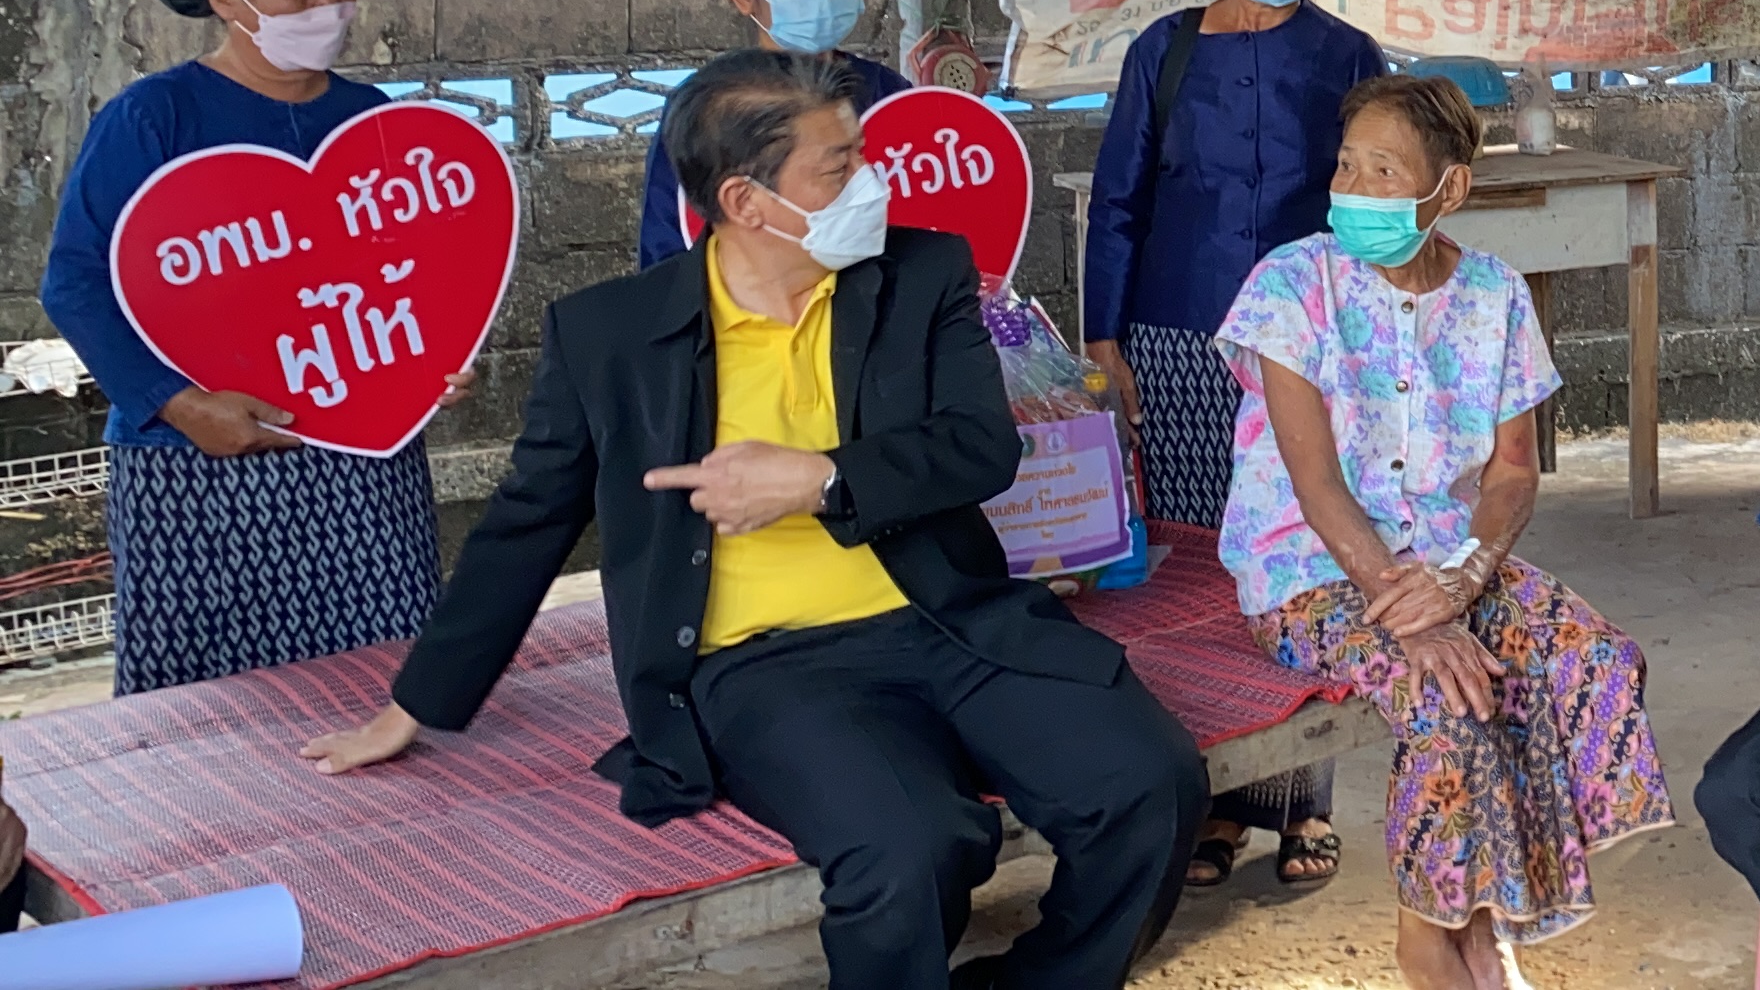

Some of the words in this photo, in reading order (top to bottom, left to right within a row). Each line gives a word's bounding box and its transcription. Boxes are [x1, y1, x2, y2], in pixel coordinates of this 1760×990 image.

[156, 210, 312, 286] อพม.
[336, 146, 476, 238] หัวใจ
[873, 127, 995, 199] หัวใจ
[275, 258, 426, 409] ผู้ให้
